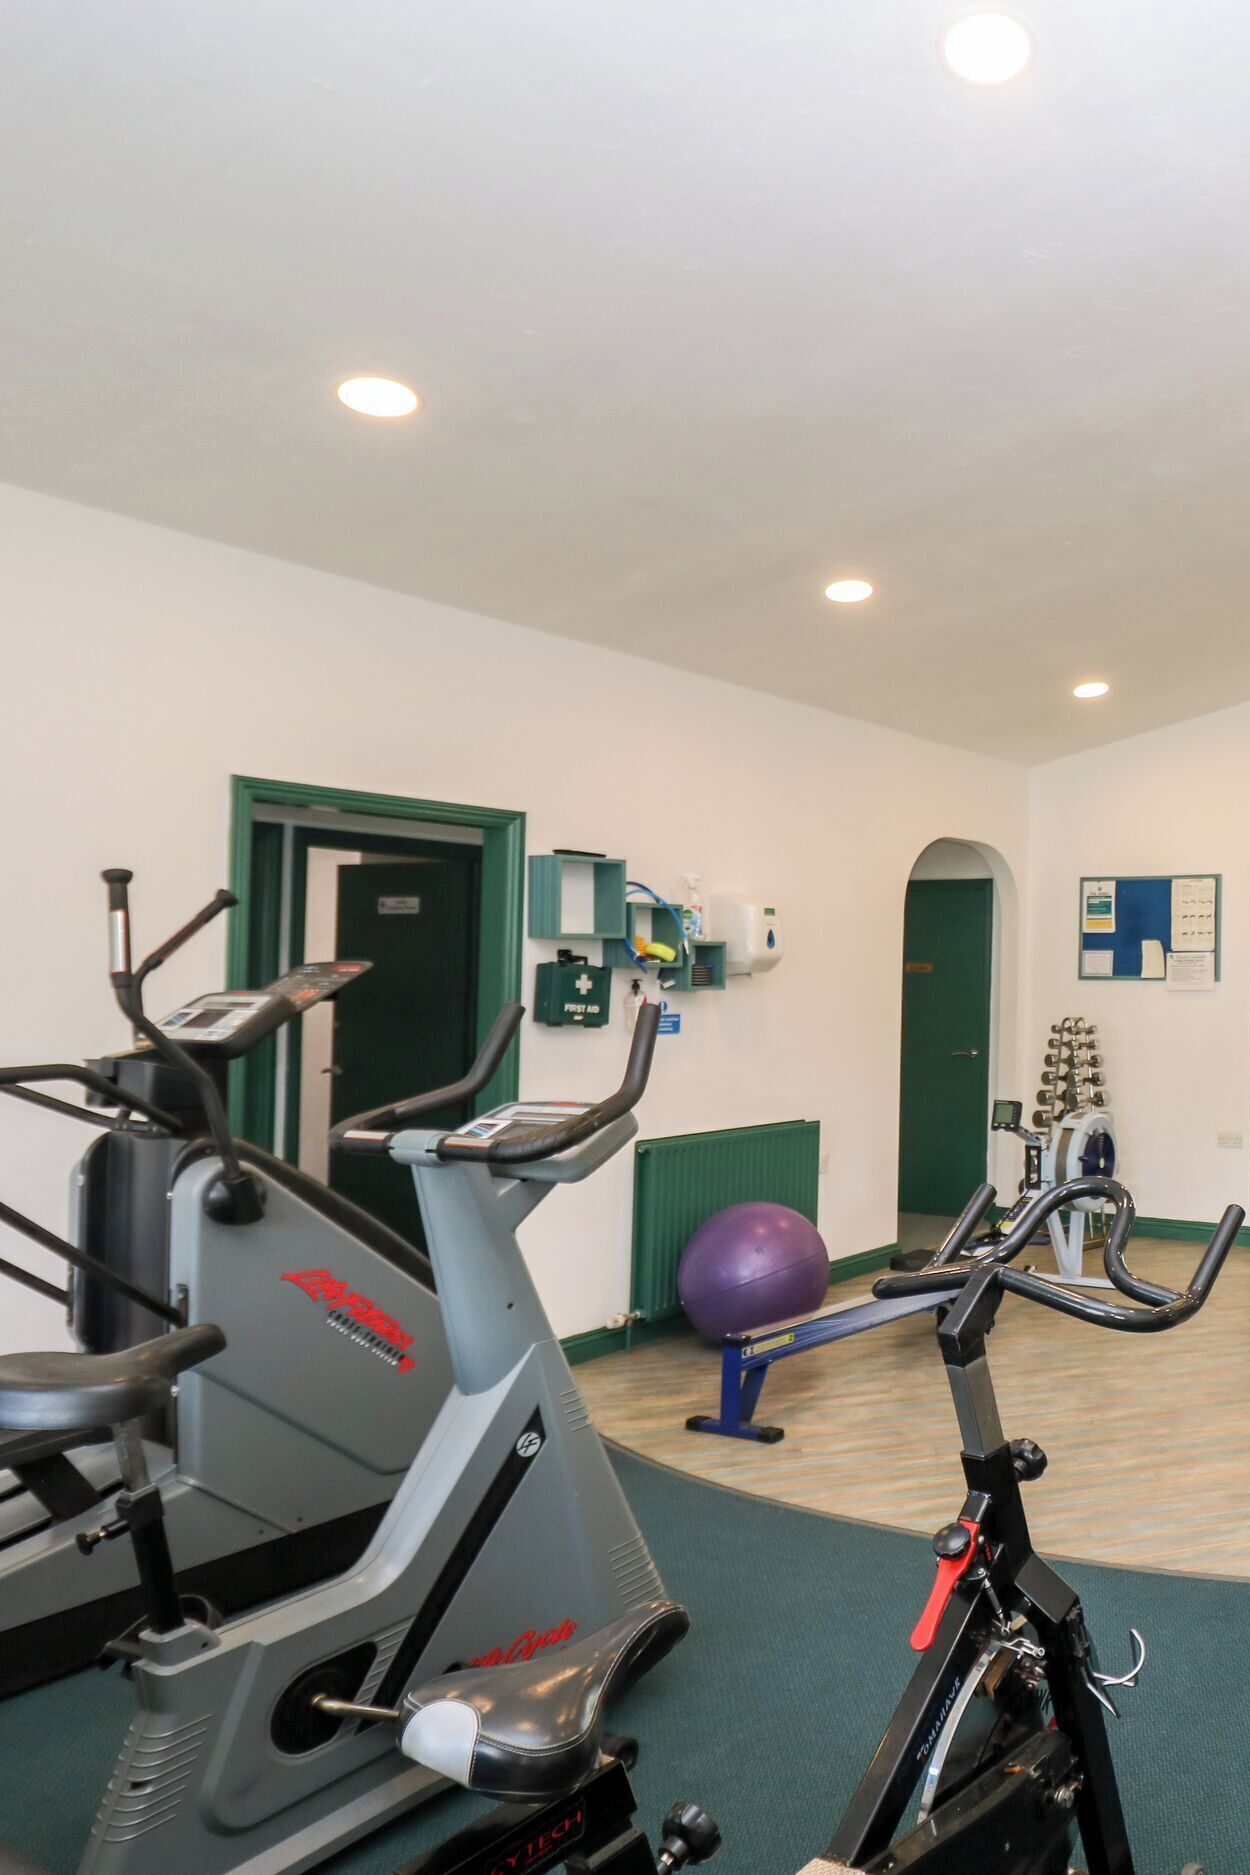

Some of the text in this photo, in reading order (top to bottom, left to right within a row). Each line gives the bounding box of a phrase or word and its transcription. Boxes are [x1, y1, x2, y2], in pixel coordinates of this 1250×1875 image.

[564, 1003, 600, 1014] FIRST AID
[916, 1676, 961, 1762] TOMAHAWK
